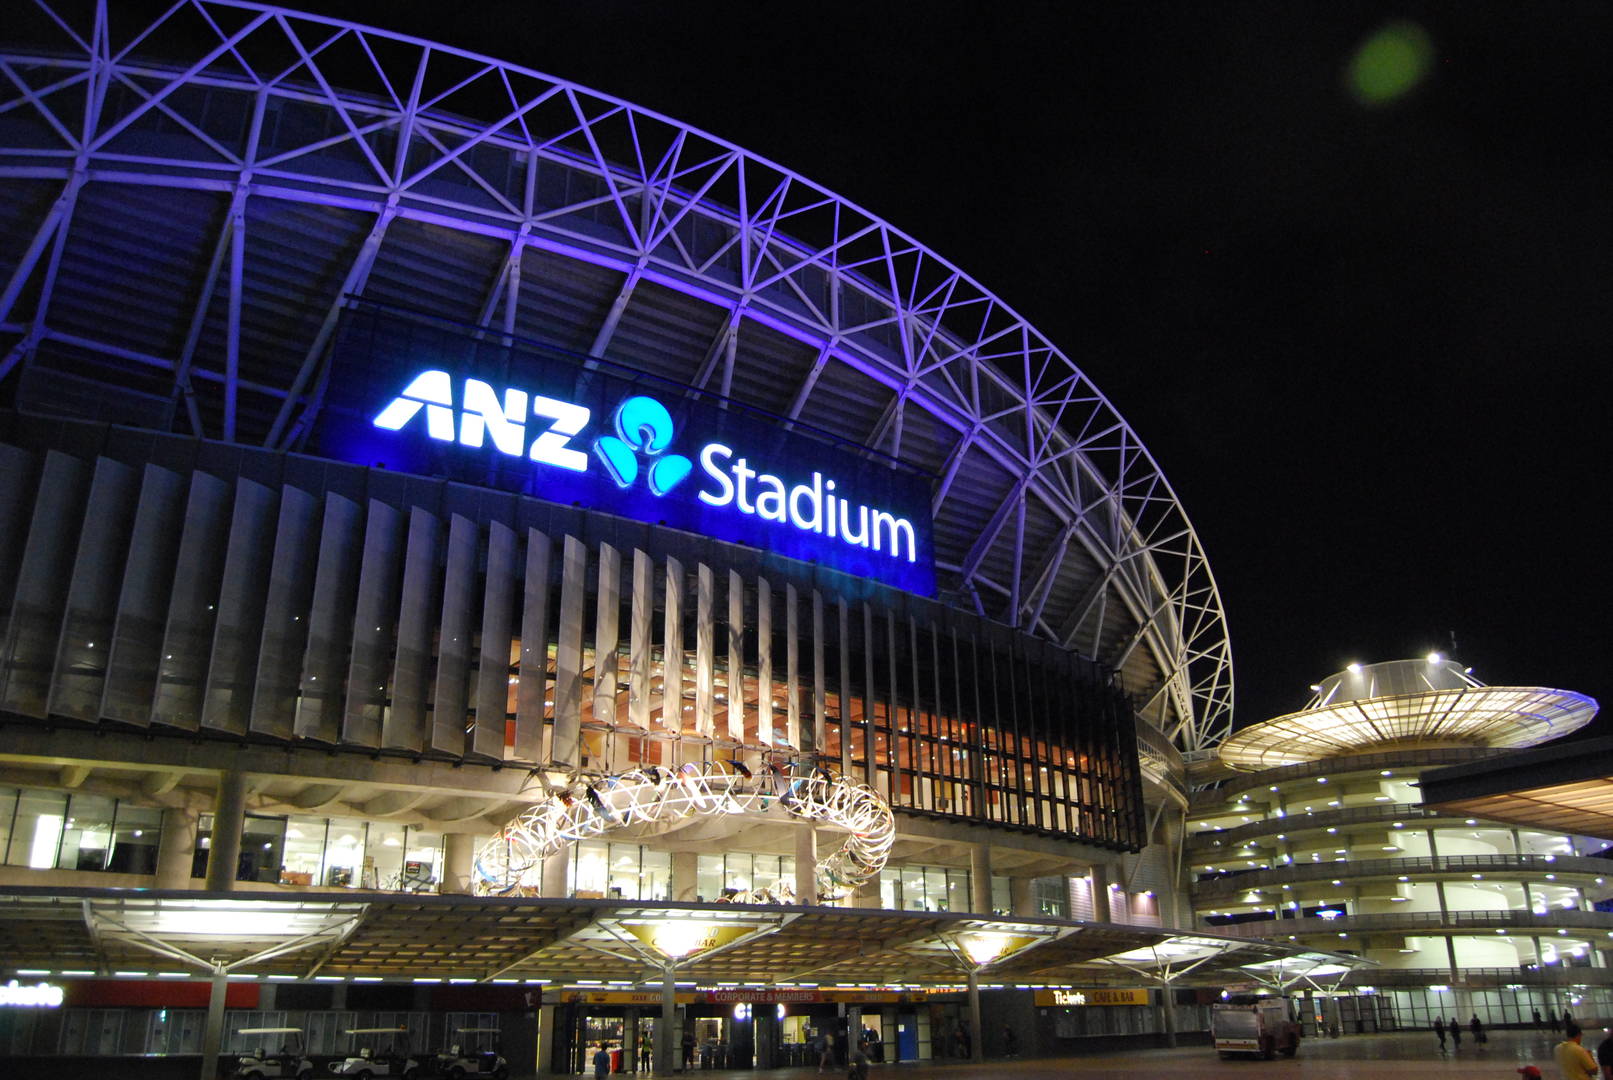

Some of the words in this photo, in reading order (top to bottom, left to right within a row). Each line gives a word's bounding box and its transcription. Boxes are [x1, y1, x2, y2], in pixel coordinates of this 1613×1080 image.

[373, 368, 591, 472] ANZ
[698, 442, 917, 563] Stadium
[714, 991, 765, 1002] CORPORATE
[774, 991, 815, 1002] MEMBERS
[1053, 990, 1086, 1005] Tickets
